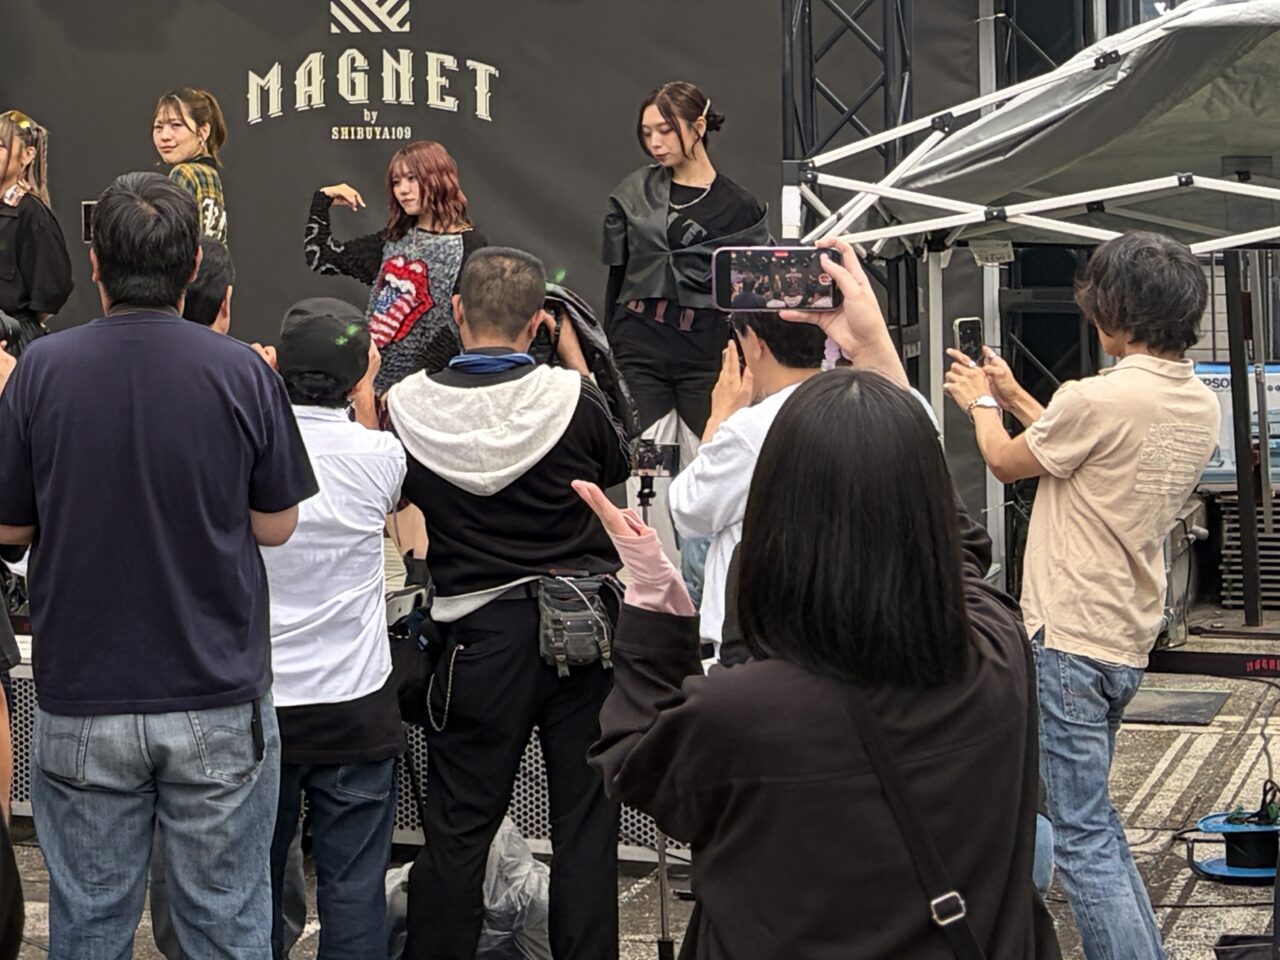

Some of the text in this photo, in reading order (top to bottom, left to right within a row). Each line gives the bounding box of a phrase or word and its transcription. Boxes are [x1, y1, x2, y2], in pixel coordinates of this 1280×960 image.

[247, 48, 499, 125] MAGNET
[362, 108, 378, 124] by
[331, 126, 412, 140] SHIBUYA109
[1201, 377, 1231, 389] PSO
